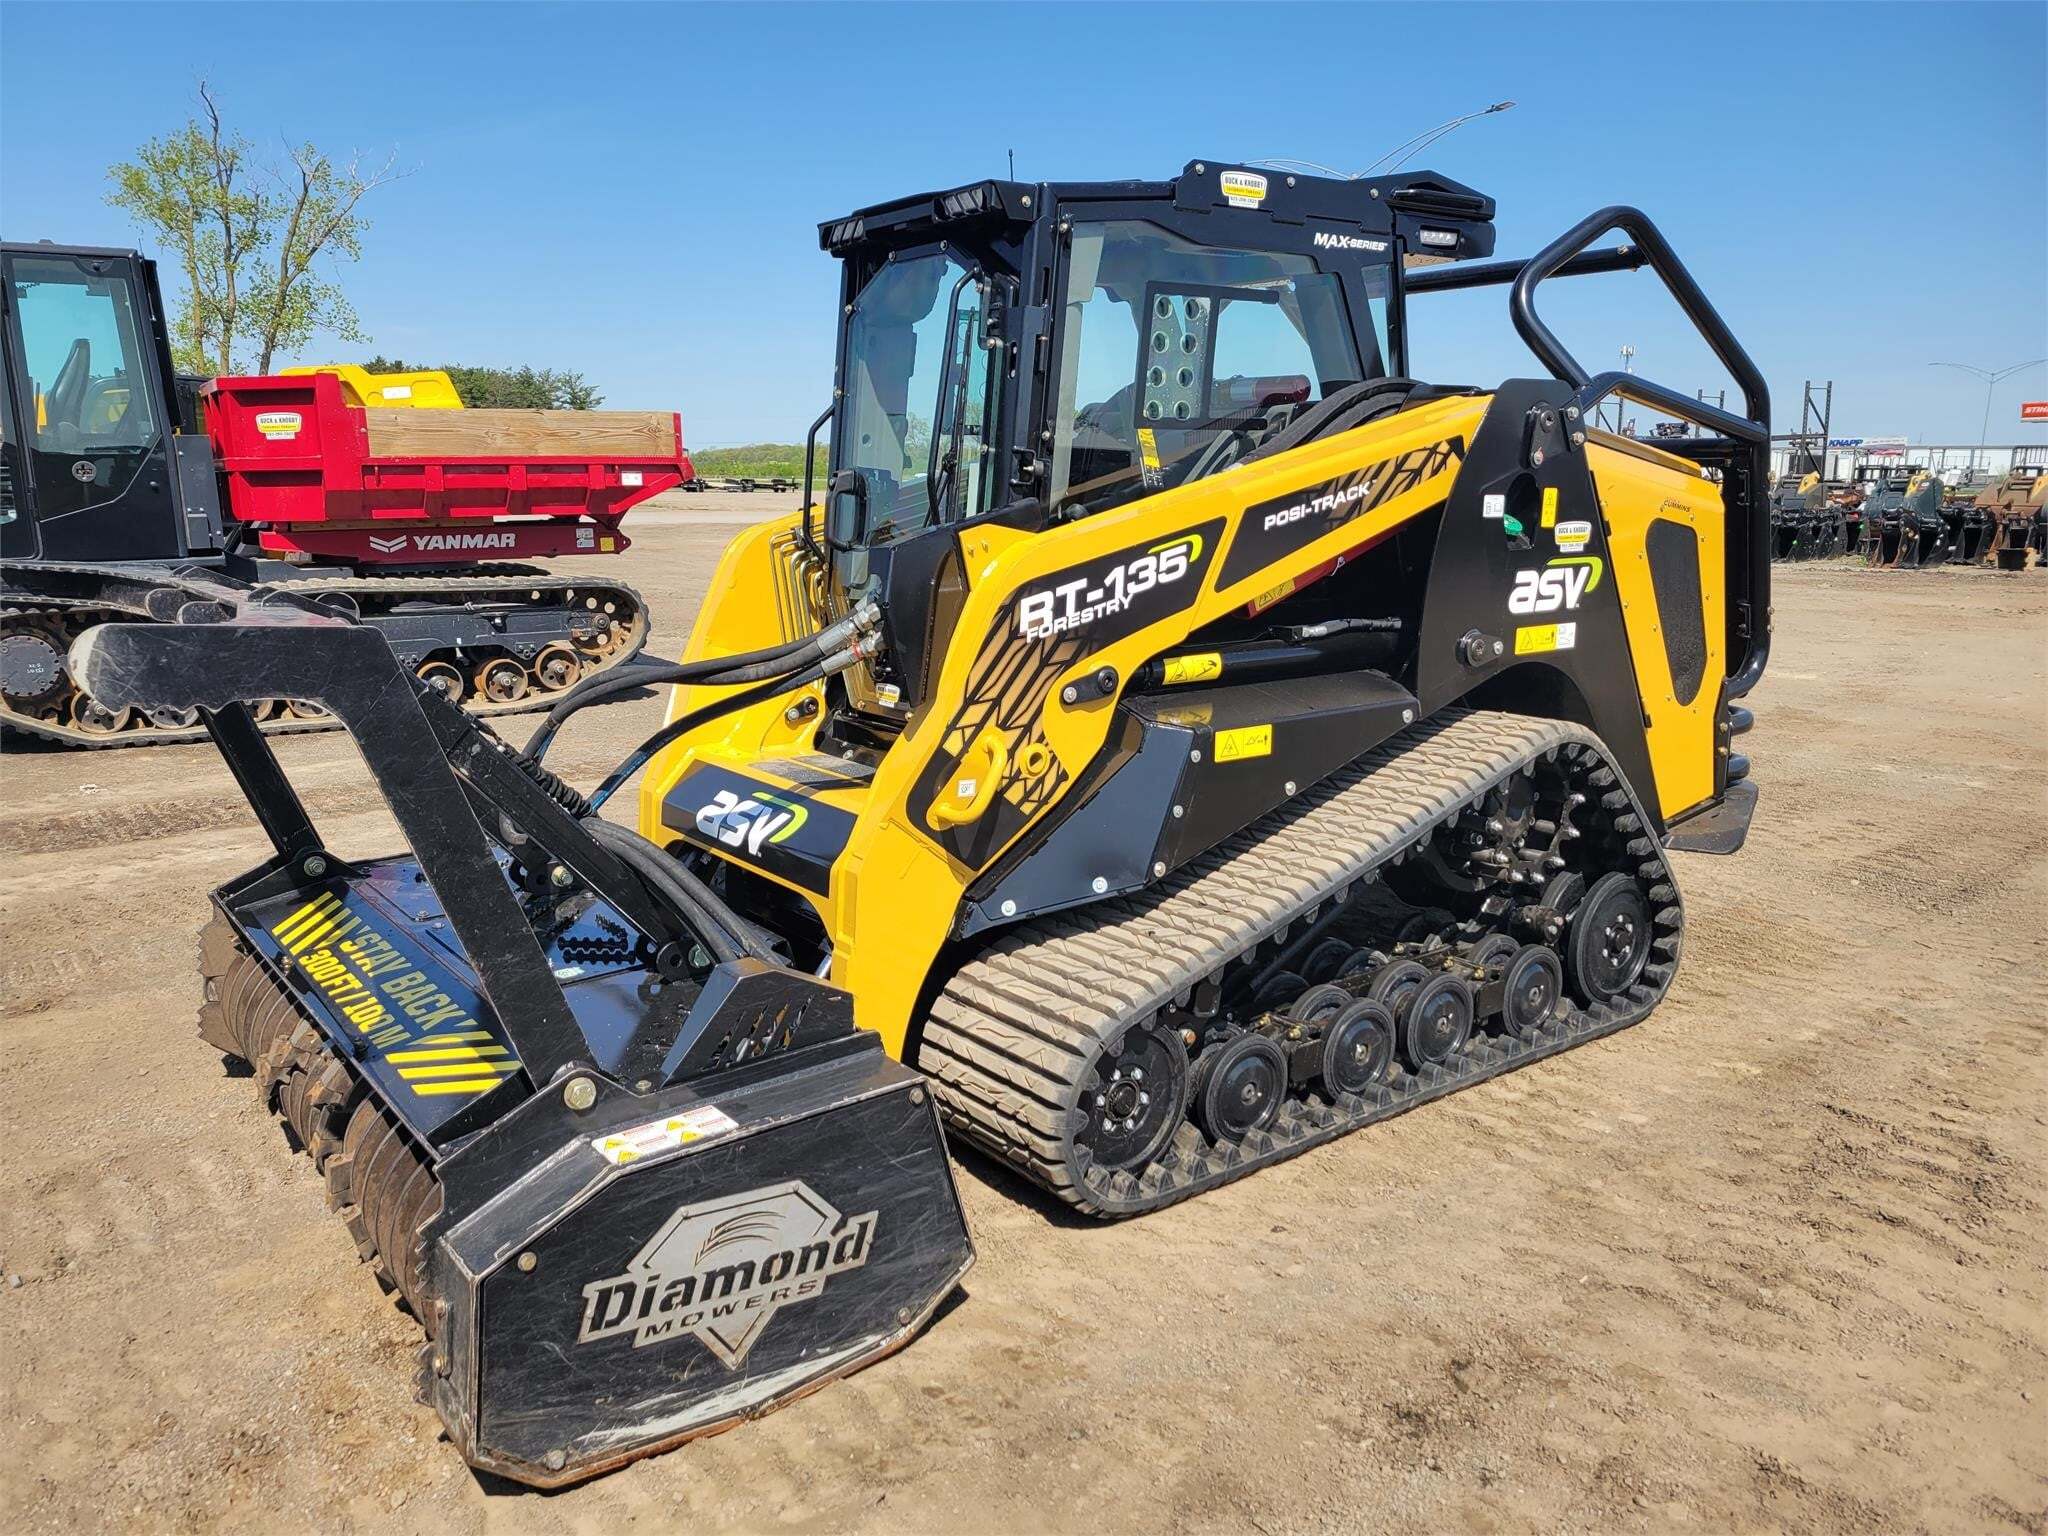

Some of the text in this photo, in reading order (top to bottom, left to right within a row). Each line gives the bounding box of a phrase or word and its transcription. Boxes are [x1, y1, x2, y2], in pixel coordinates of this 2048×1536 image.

[1313, 232, 1388, 252] MAX-SERIES
[1828, 439, 1864, 447] KNAPP
[1263, 481, 1371, 532] POSI-TRACK
[1663, 500, 1691, 513] CUMMINS
[413, 533, 516, 551] YANMAR
[1018, 544, 1188, 634] RT-135
[1026, 593, 1134, 645] FORESTRY
[340, 932, 467, 1032] STAY BACK
[587, 1219, 872, 1334] Diamond
[643, 1280, 818, 1339] MOWERS
